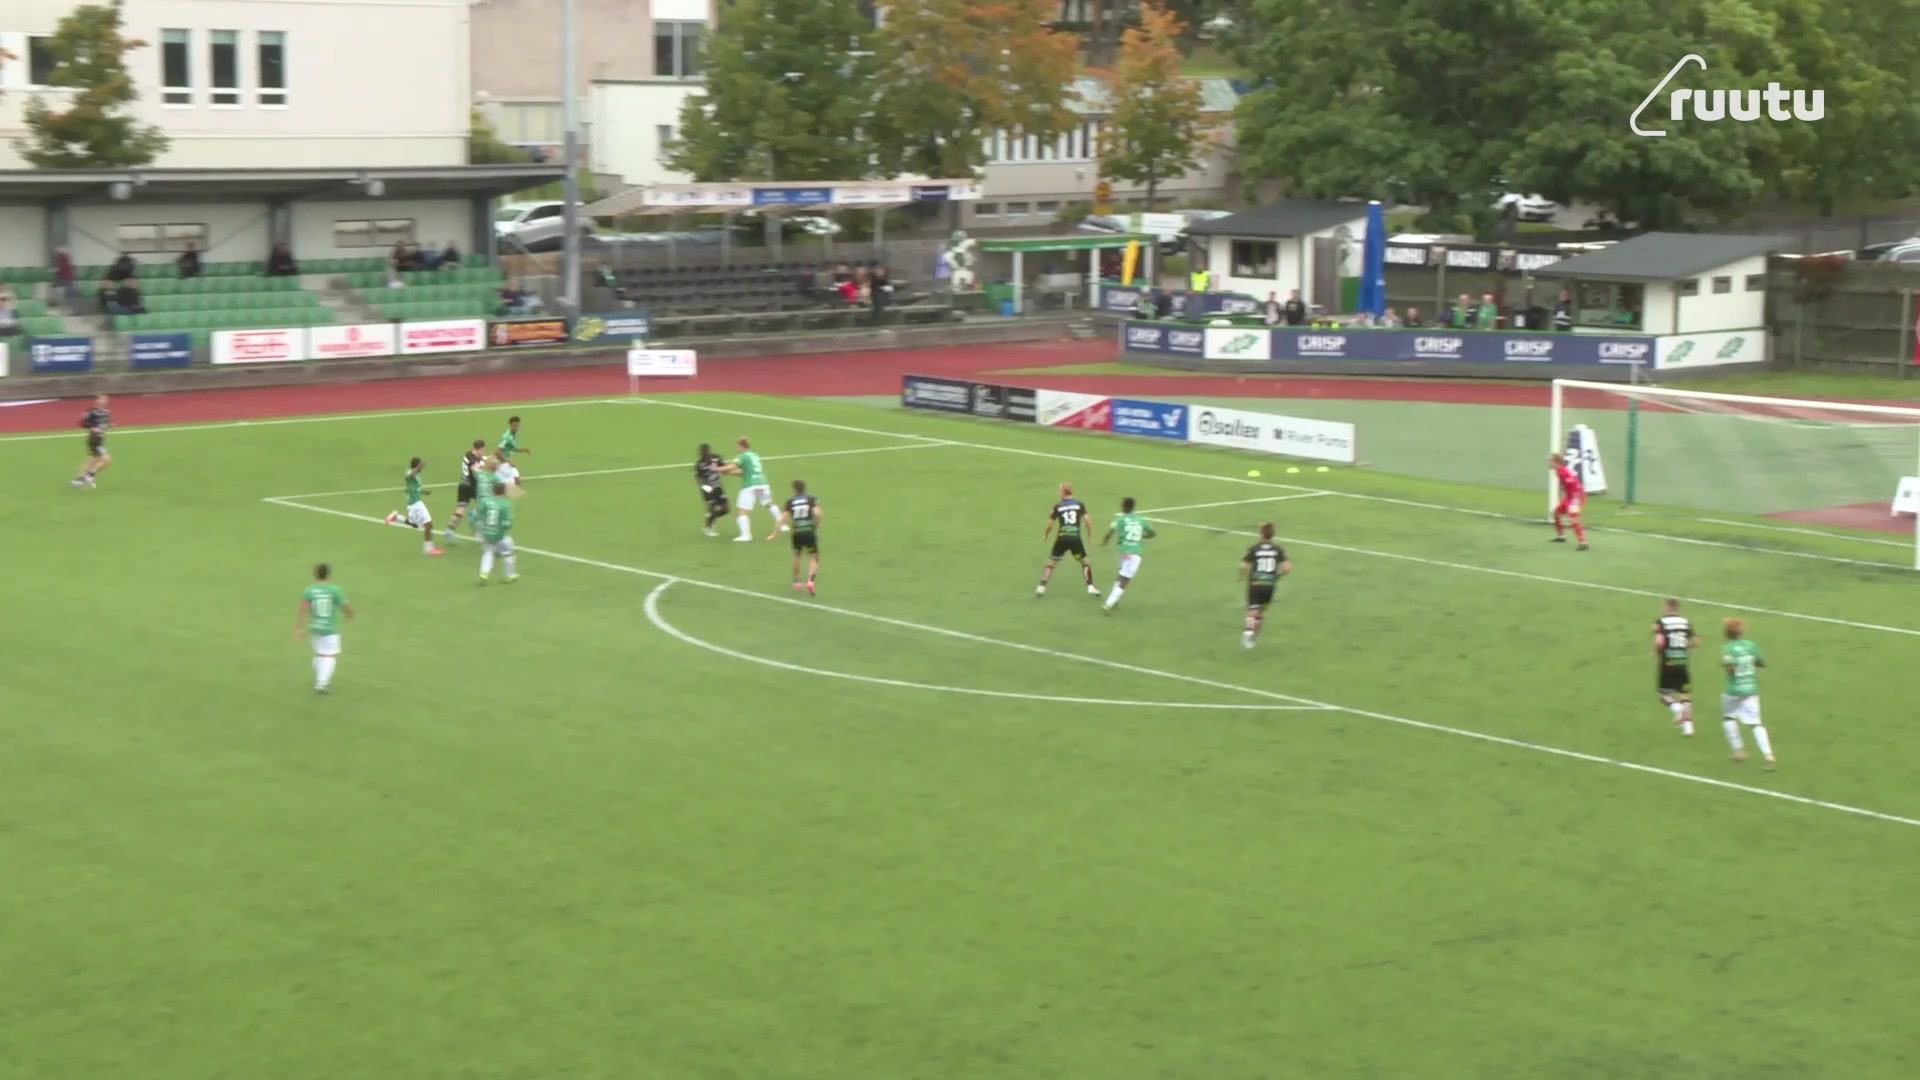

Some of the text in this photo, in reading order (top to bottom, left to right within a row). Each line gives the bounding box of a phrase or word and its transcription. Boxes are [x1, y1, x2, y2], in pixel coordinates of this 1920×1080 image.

[1298, 335, 1346, 351] CRISP
[1415, 337, 1462, 353] CRISP
[1504, 340, 1553, 356] CRISP
[1599, 343, 1649, 359] CRISP
[1061, 511, 1077, 525] 13
